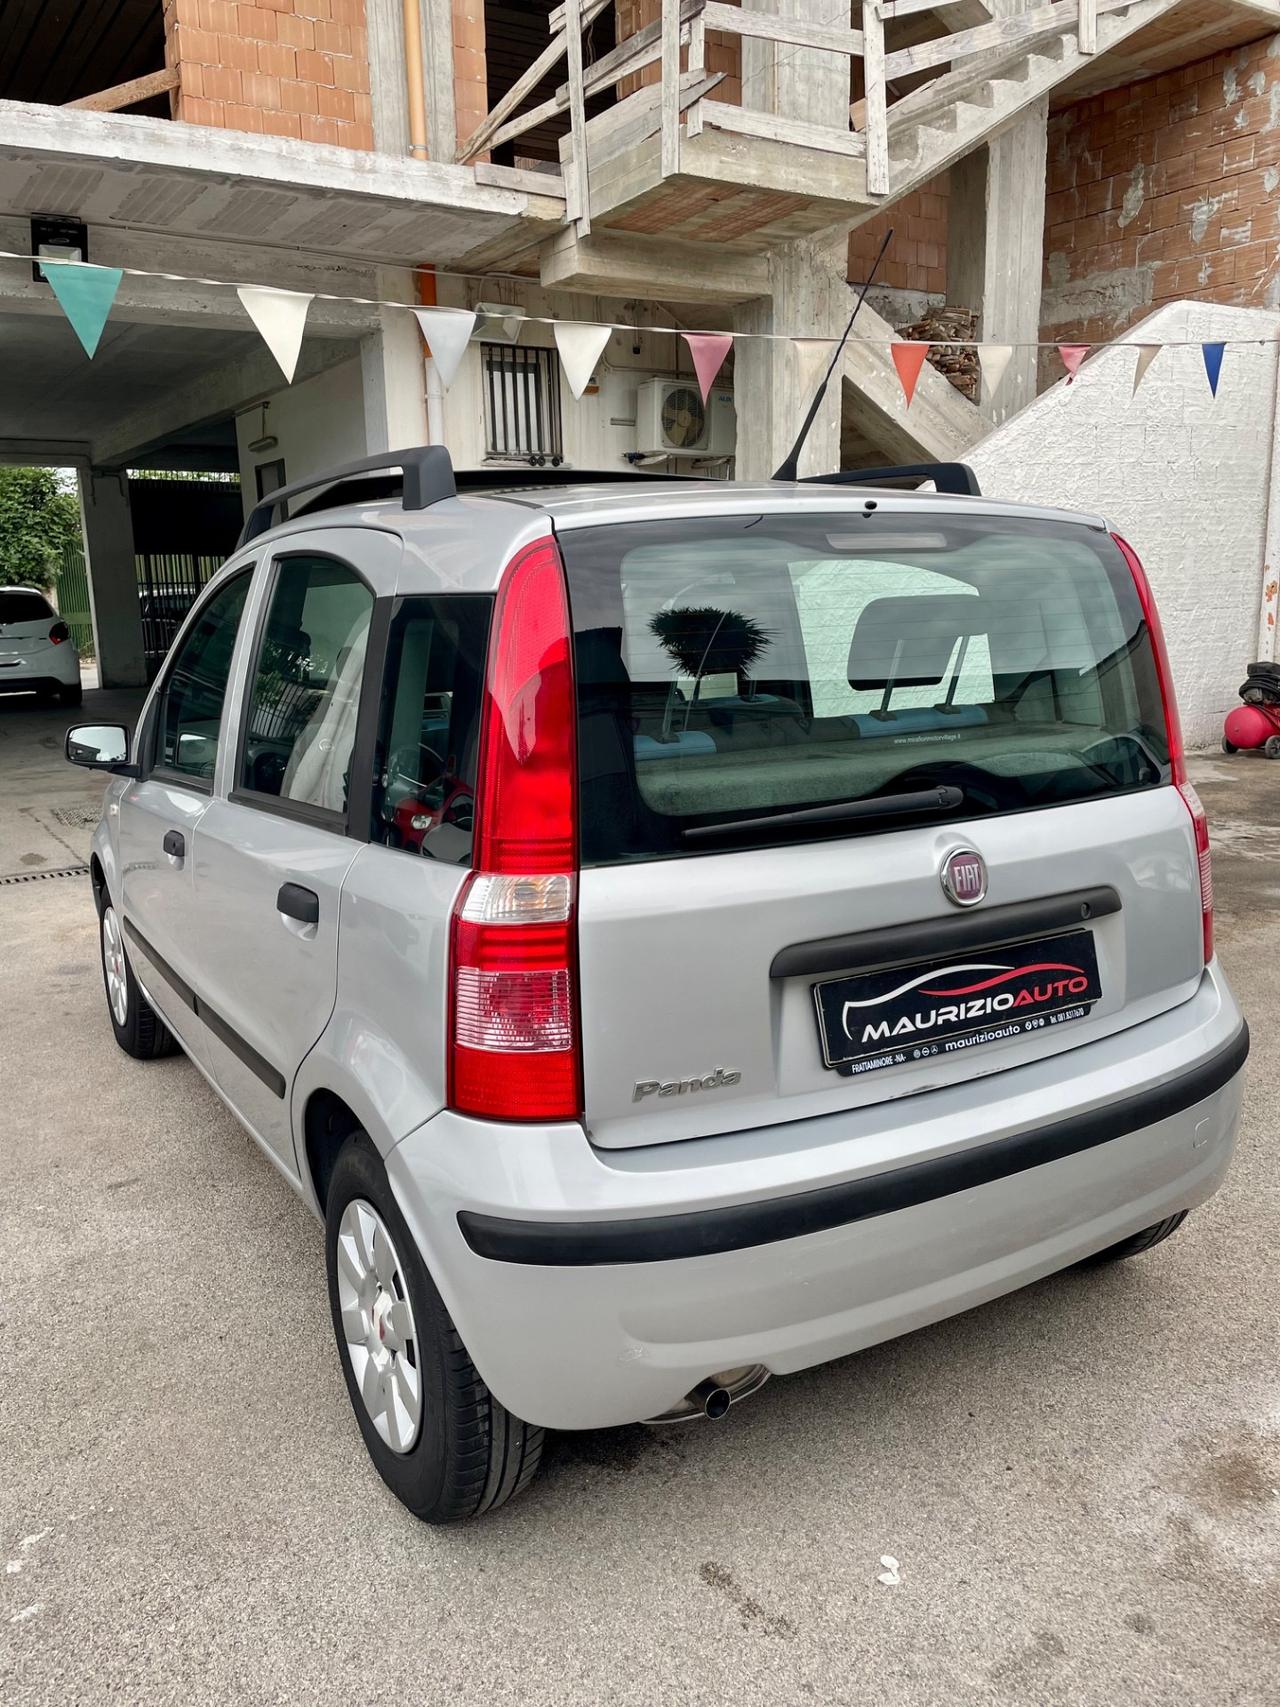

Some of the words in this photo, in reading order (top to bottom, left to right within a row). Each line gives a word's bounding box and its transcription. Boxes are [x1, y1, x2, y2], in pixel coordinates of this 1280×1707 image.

[953, 863, 979, 893] FIAT
[861, 976, 1089, 1043] MAURIZIOAUTO
[851, 1056, 893, 1074] FRATTAMINORE
[945, 1024, 1021, 1051] maurizioauto
[632, 1067, 742, 1103] Panda
